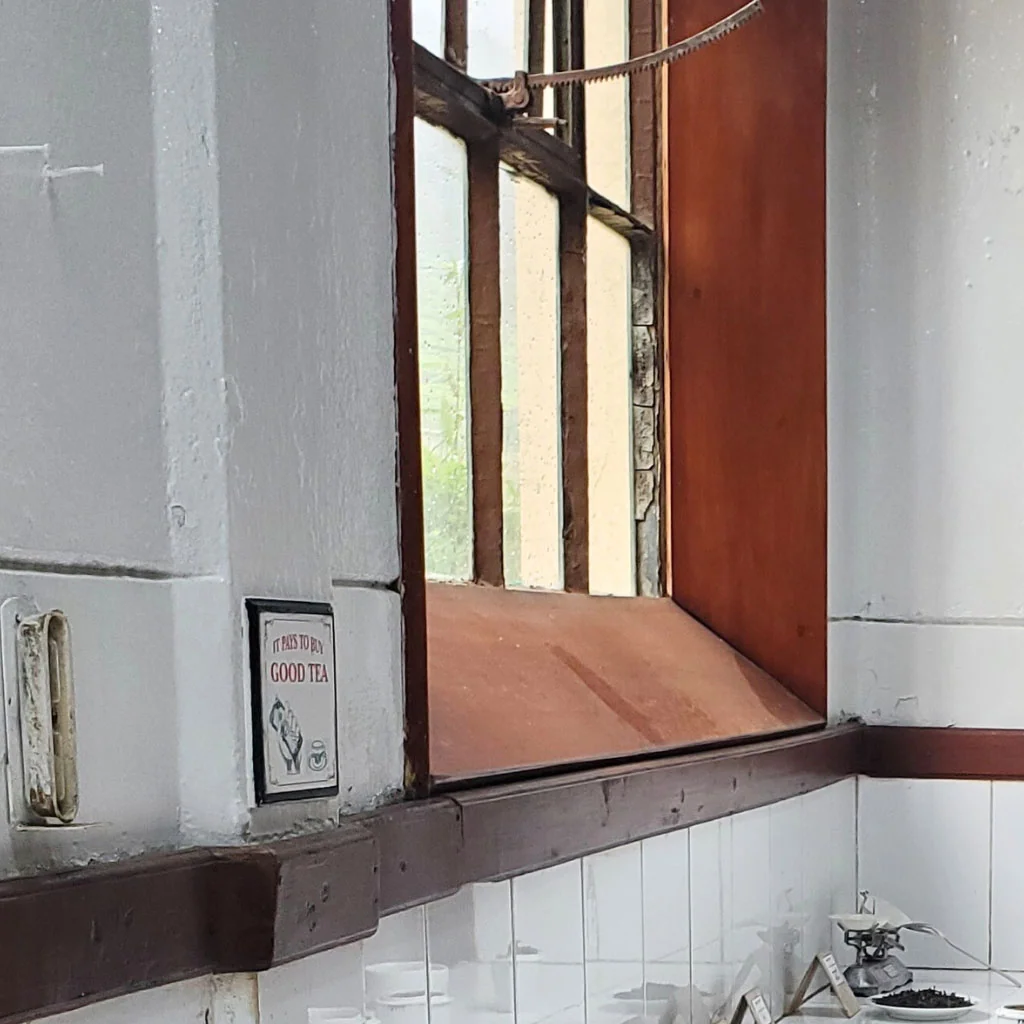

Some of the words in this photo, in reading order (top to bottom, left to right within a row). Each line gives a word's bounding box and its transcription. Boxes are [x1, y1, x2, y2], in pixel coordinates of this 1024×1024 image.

[272, 637, 281, 654] IT
[281, 634, 298, 651] PAYS
[299, 633, 310, 650] TO
[310, 636, 324, 655] BUY
[270, 661, 306, 682] GOOD
[307, 663, 329, 682] TEA
